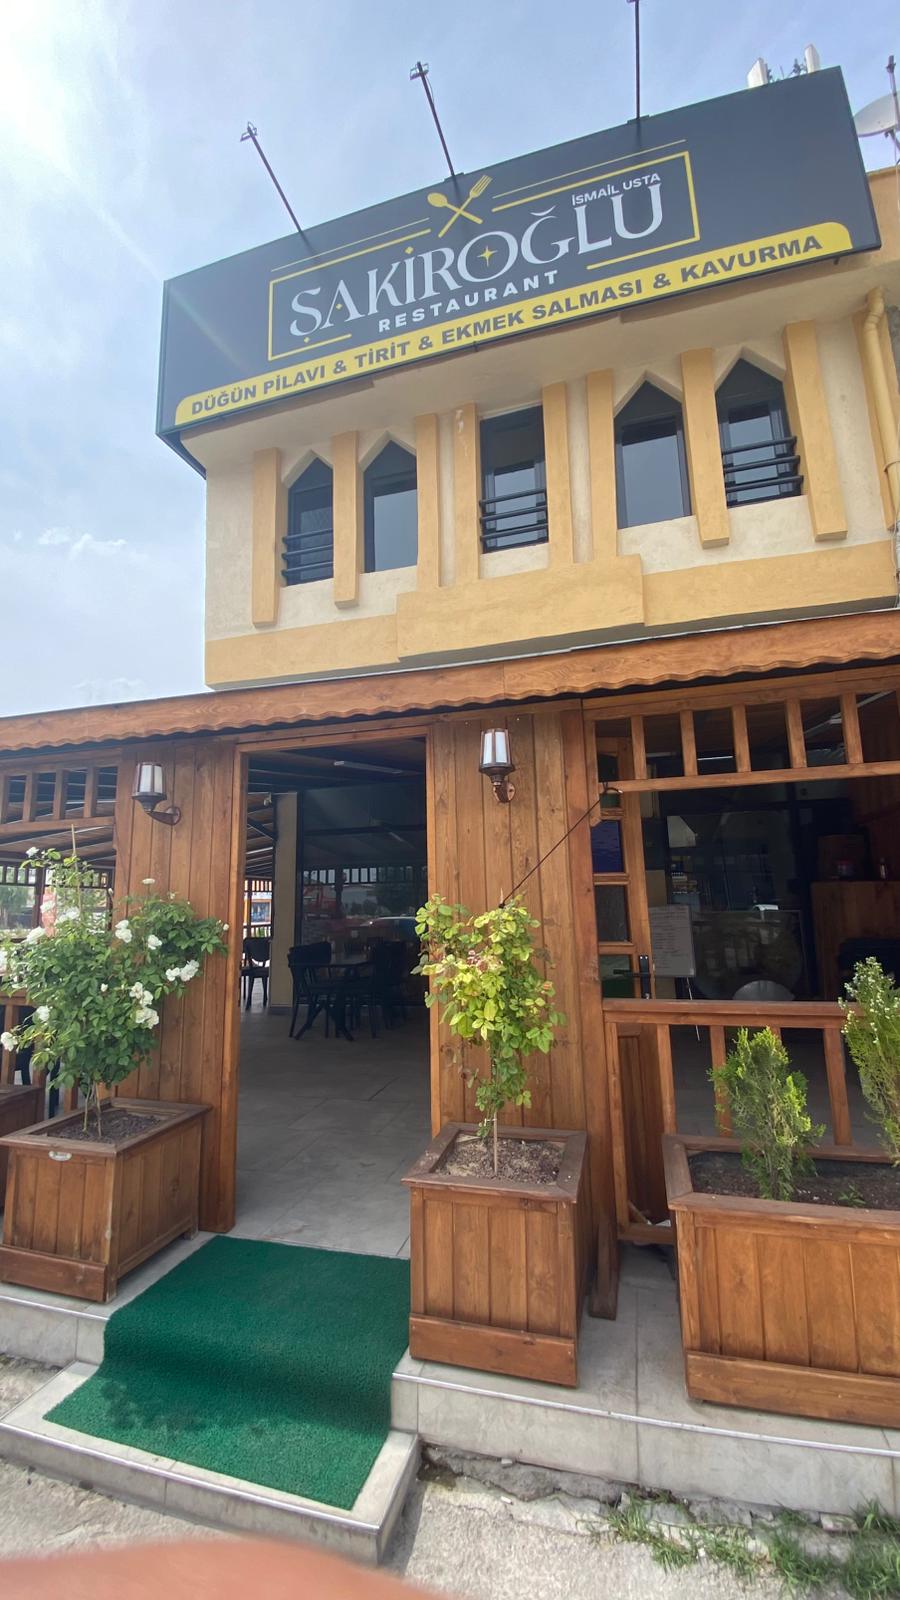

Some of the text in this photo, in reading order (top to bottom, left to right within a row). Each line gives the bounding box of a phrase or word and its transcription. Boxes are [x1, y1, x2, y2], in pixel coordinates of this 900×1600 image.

[622, 173, 661, 190] USTA
[289, 183, 664, 344] ŞAKİROĞLU
[378, 269, 559, 334] RESTAURANT
[191, 234, 824, 416] DÜĞÜN PİLAVI & TİRİT & EKMEK SALMASI & KAVURMA
